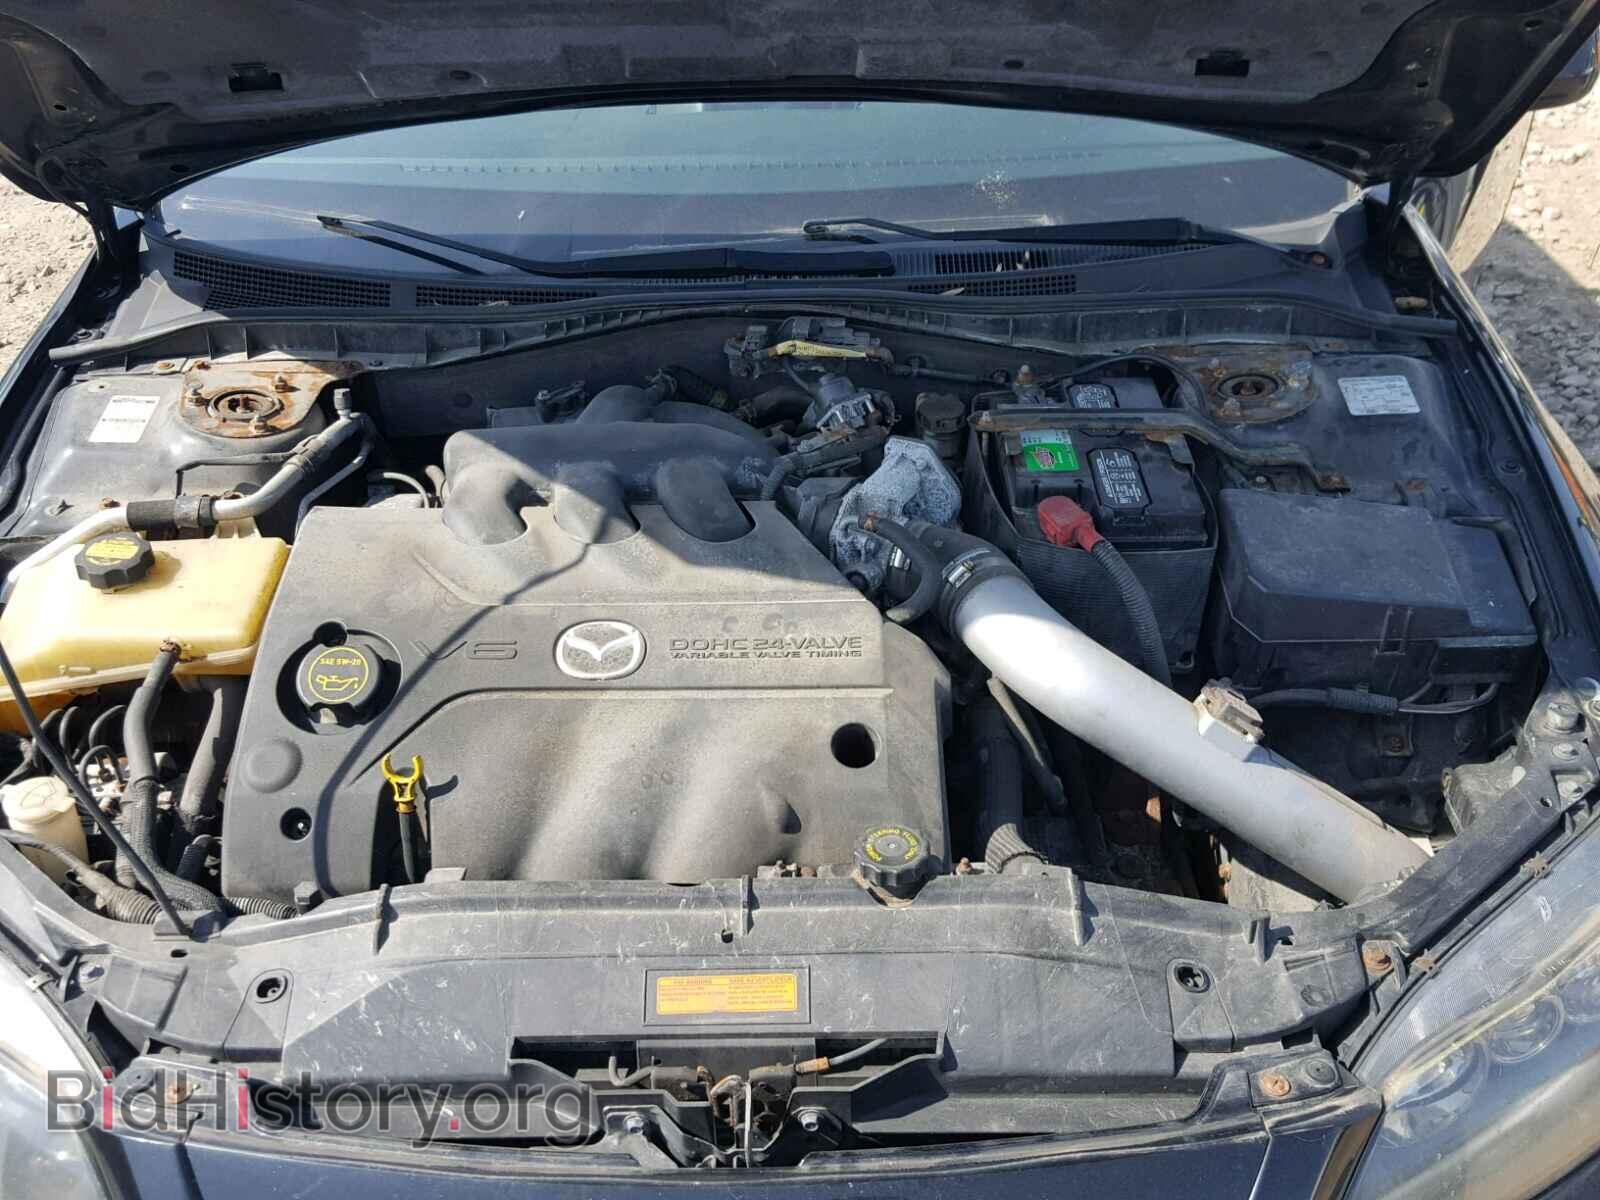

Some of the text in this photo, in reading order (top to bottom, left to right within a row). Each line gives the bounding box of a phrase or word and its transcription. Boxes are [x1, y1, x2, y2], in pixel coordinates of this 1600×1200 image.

[408, 639, 518, 661] V6
[670, 636, 862, 651] DOHC 24-VALVE
[670, 650, 862, 660] VARIABLE VALVE TIMING
